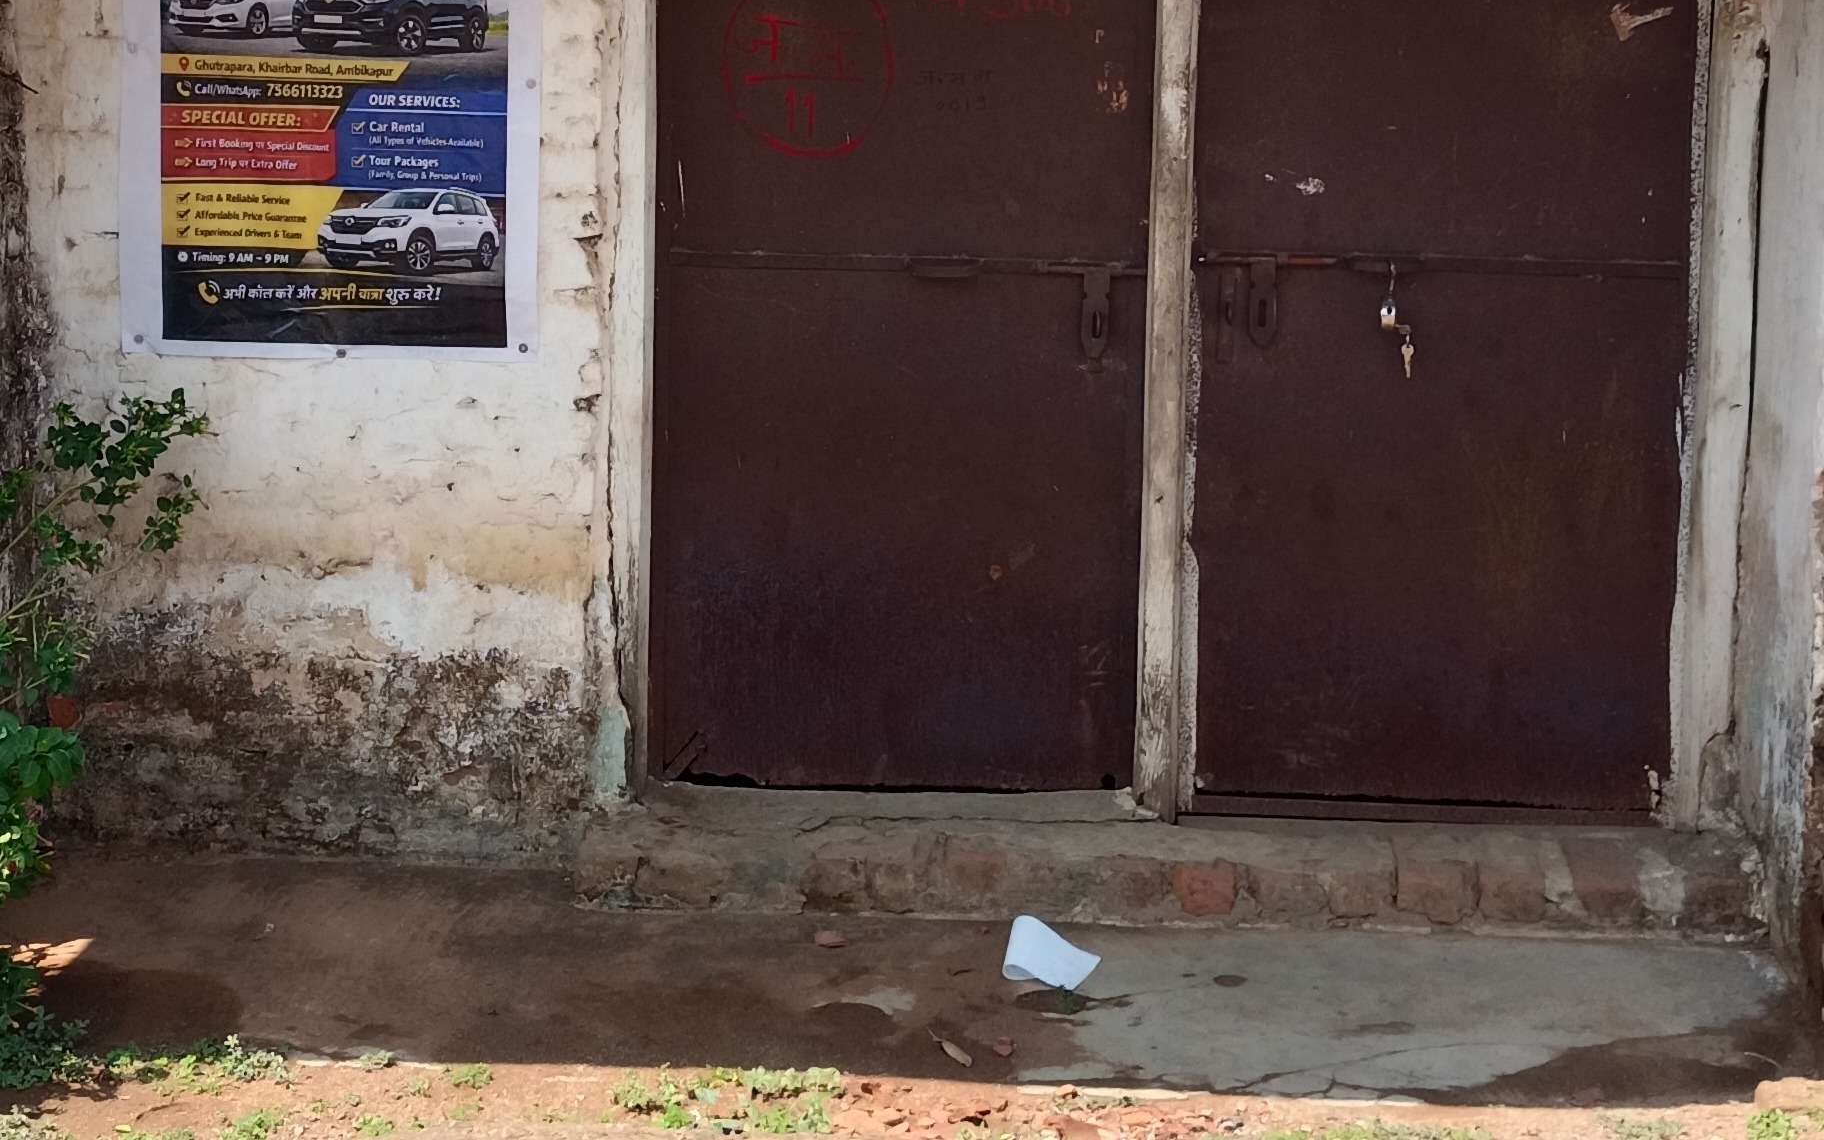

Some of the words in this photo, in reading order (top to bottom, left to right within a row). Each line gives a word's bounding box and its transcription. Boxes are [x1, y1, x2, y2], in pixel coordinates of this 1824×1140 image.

[195, 59, 256, 74] Ghutrapara,
[259, 62, 302, 73] Khairbar
[305, 64, 333, 76] Road,
[336, 65, 394, 78] Ambikapur
[195, 84, 262, 99] Call/WhatsApp:
[267, 83, 343, 99] 7566113323
[369, 94, 396, 106] OUR
[398, 95, 460, 108] SERVICES:
[181, 109, 246, 125] SPECIAL
[249, 112, 301, 127] OFFER:
[369, 121, 388, 132] Car
[391, 121, 424, 133] Rental
[195, 138, 216, 148] First
[219, 138, 253, 151] Booking
[267, 141, 294, 152] Special
[297, 142, 329, 152] Discount
[369, 136, 381, 146] (All
[383, 136, 404, 146] Types
[406, 136, 414, 144] of
[195, 158, 217, 169] Long
[219, 157, 237, 169] Trip
[251, 159, 273, 169] Extra
[275, 160, 297, 170] Offer
[369, 155, 391, 166] Tour
[395, 156, 439, 169] Packages
[397, 170, 419, 181] Group
[429, 171, 460, 181] Personal
[462, 172, 482, 182] Trips)
[195, 193, 213, 202] Fast
[216, 194, 223, 202] &
[226, 193, 260, 204] Reliable
[261, 195, 291, 205] Service
[195, 210, 240, 220] Affordable
[242, 212, 263, 221] Price
[194, 227, 243, 238] Experienced
[245, 229, 271, 238] Drivers
[282, 230, 302, 239] Team
[192, 252, 226, 264] Timing:
[228, 252, 235, 263] 9
[236, 253, 253, 263] AM
[264, 253, 272, 263] 9
[274, 254, 289, 264] PM
[223, 283, 246, 300] अभी
[297, 284, 319, 299] और
[319, 282, 356, 301] अपनी
